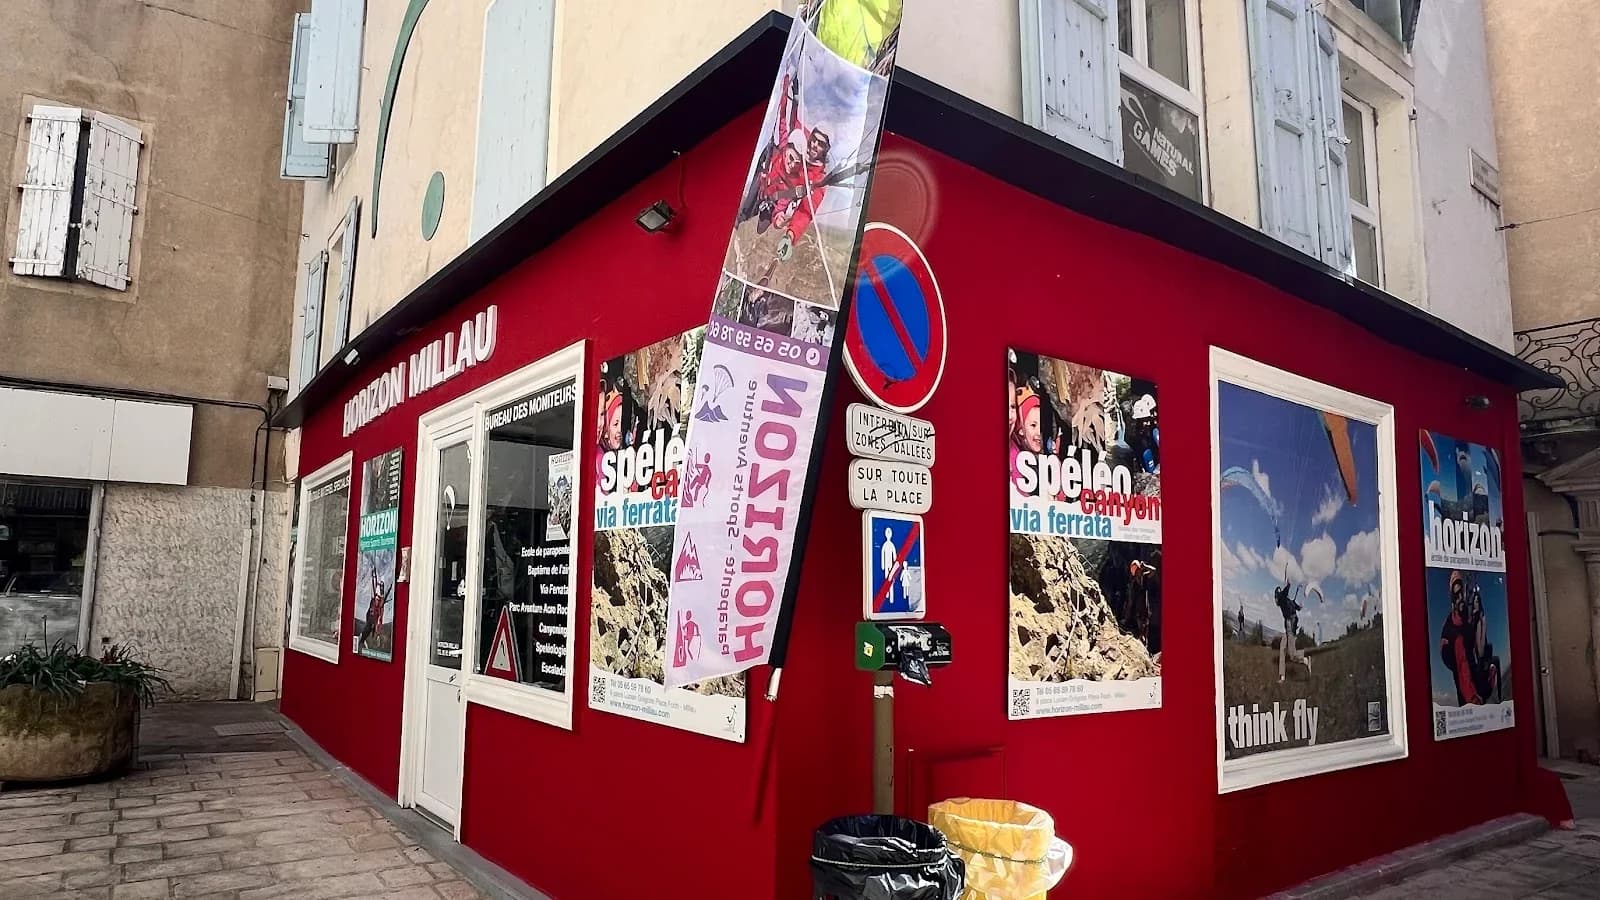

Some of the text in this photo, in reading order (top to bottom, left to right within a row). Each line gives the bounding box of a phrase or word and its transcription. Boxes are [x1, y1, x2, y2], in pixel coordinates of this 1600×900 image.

[1133, 121, 1177, 177] GAMES
[1152, 127, 1194, 175] NATURAL
[343, 305, 497, 437] HORIZON MILLAU
[485, 382, 576, 431] BUREAU DES MONITEURS
[855, 432, 886, 450] ZONES
[912, 425, 931, 440] SUR
[857, 467, 928, 485] SUR TOUTE
[1016, 445, 1132, 497] spéléo
[863, 488, 923, 504] LA PLACE
[1080, 488, 1161, 526] canyon
[361, 510, 397, 538] HORIZON
[597, 500, 617, 528] via
[1011, 503, 1112, 537] via ferrata
[1429, 500, 1501, 558] horizon
[521, 547, 535, 557] Ecole
[536, 546, 543, 557] de
[551, 564, 558, 575] de
[540, 583, 569, 595] Via Ferrata
[509, 602, 521, 613] Parc
[538, 622, 568, 638] Canyoning
[1228, 699, 1319, 748] think fly
